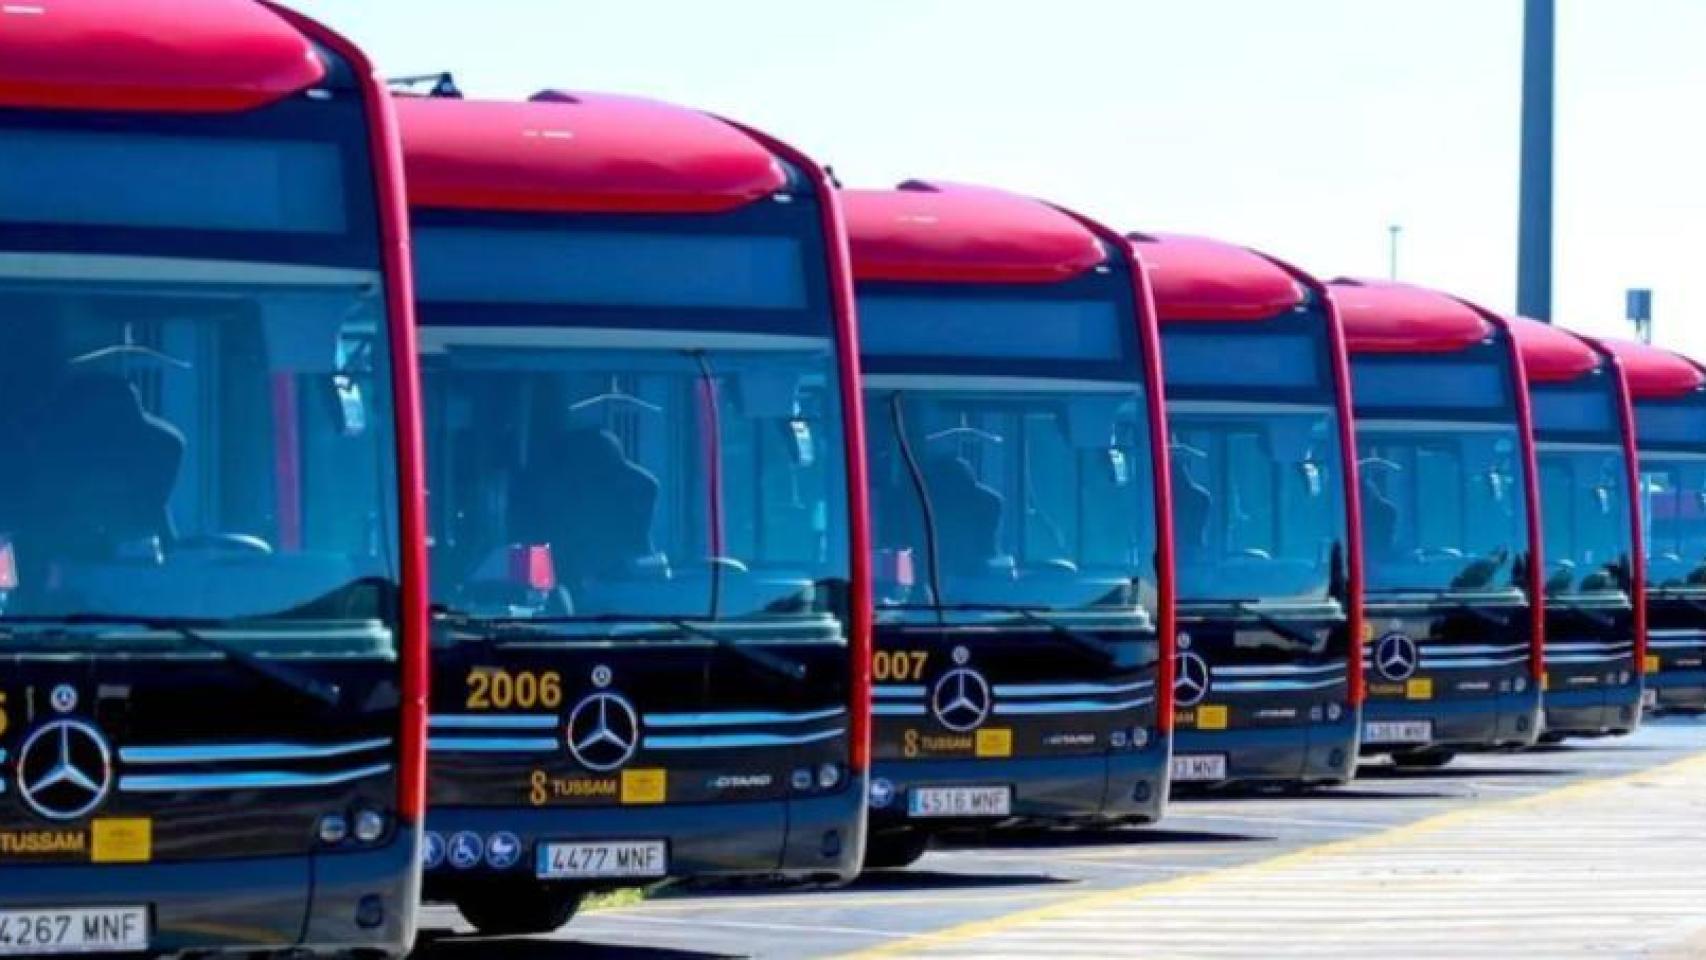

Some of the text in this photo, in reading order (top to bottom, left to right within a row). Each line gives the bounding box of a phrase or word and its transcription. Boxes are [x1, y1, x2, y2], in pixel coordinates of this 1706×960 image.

[873, 652, 928, 680] 007
[466, 669, 562, 709] 2006
[552, 779, 617, 797] TUSSAM
[0, 832, 84, 853] TUSSAM
[552, 845, 659, 871] 4477 MNF
[0, 911, 138, 946] 4267 MNF
